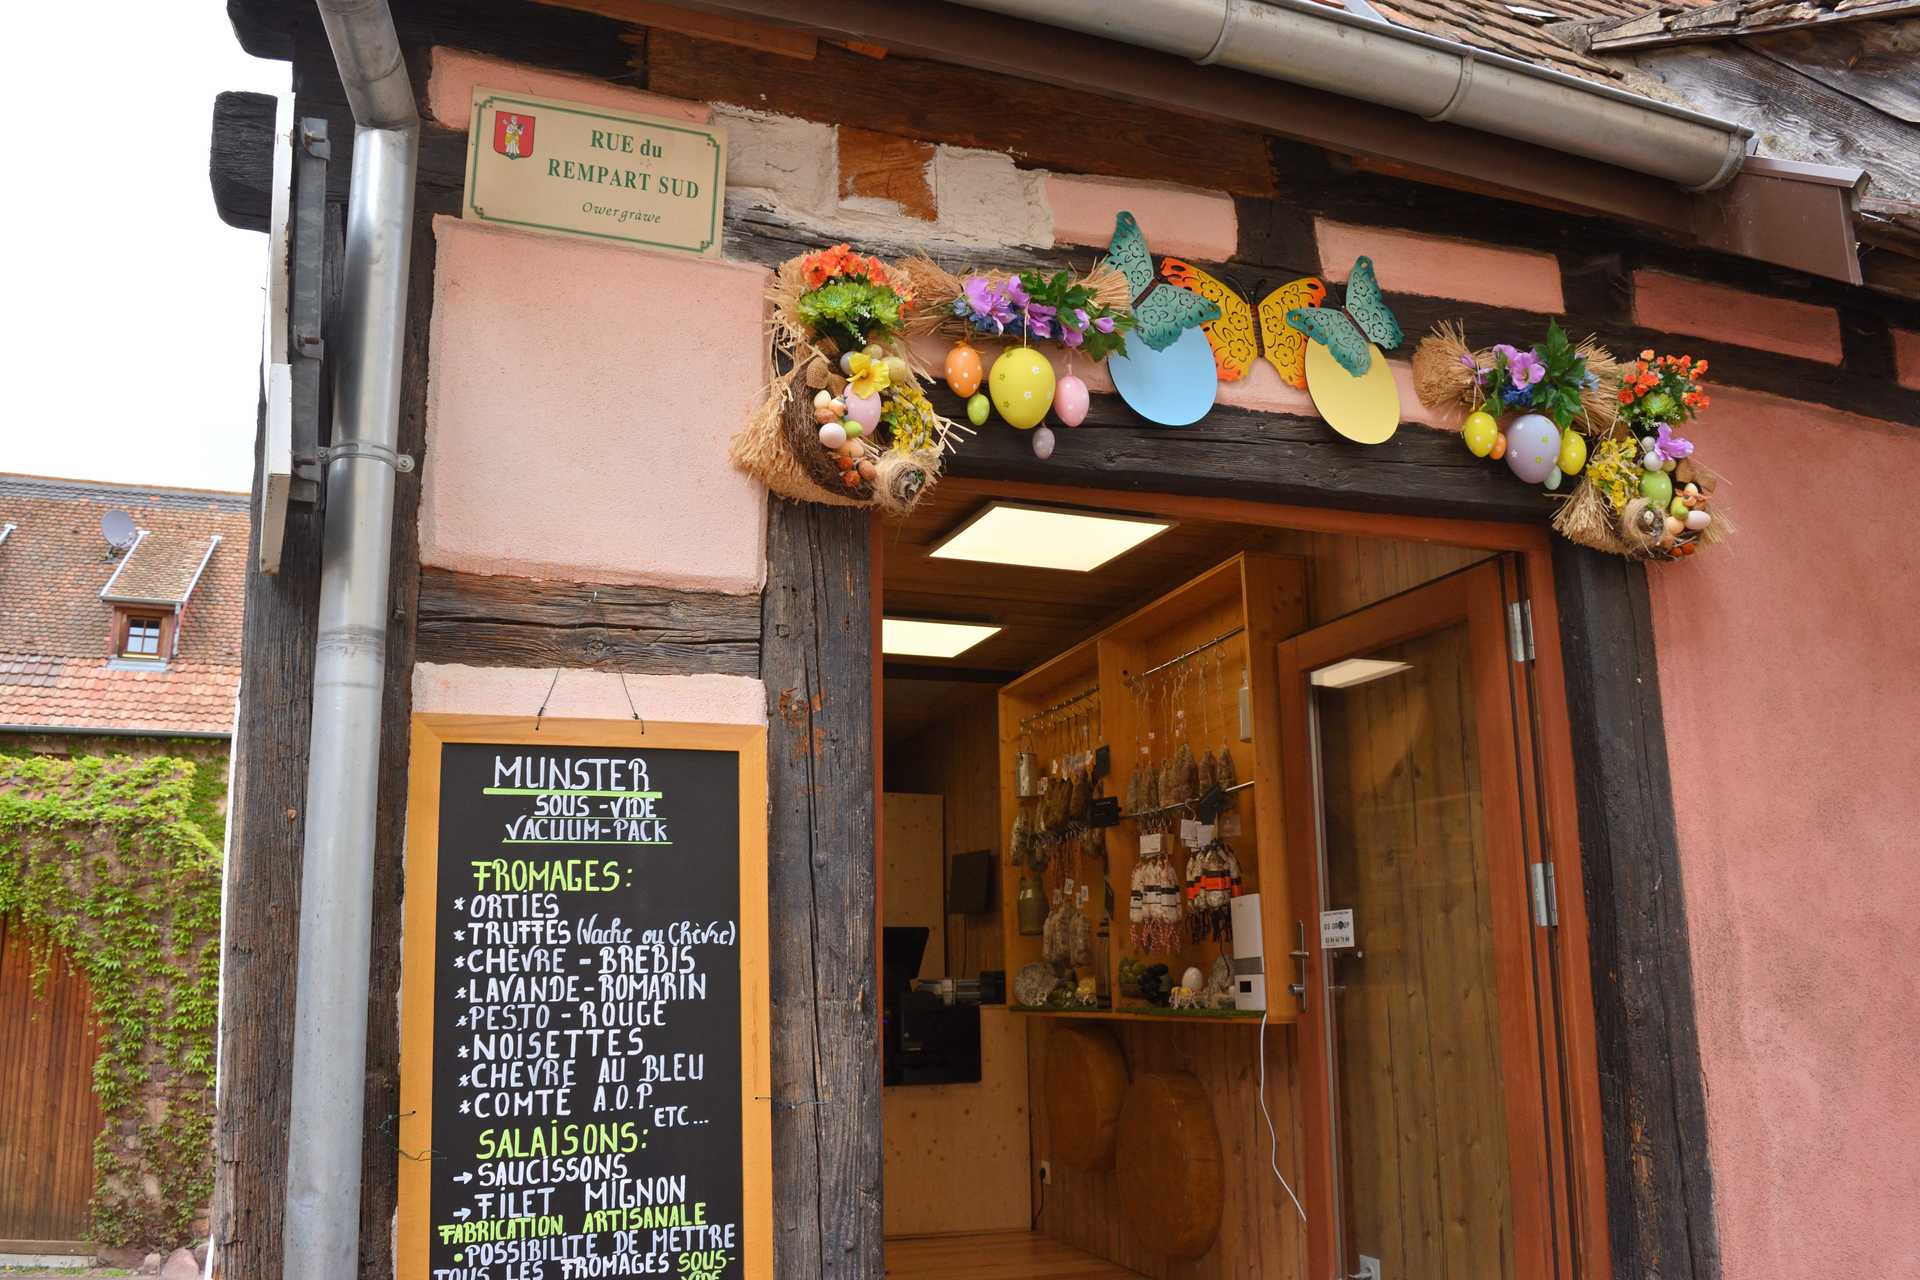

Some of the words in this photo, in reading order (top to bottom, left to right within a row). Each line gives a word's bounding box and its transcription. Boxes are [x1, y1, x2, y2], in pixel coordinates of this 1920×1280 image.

[591, 129, 634, 154] RUE
[639, 138, 663, 158] du
[547, 158, 652, 191] REMPART
[658, 176, 699, 199] SUD
[493, 756, 650, 792] MUNSTER
[534, 796, 590, 817] SOUS
[470, 890, 560, 919] ORTIES
[467, 919, 572, 945] TRUFFES
[576, 913, 633, 946] (Vache
[642, 928, 665, 945] ou
[467, 944, 566, 974] CHÈVRE
[598, 943, 696, 974] BREBIS
[468, 1003, 550, 1031] PESTO
[579, 1000, 667, 1028] ROUGE
[473, 1027, 644, 1061] NOISETTES
[471, 1055, 577, 1089] CHÈVRE
[598, 1058, 625, 1085] AU
[642, 1053, 704, 1081] BLEU
[474, 1085, 572, 1119] COMTÉ
[478, 1153, 628, 1187] SAUCISSONS
[474, 1186, 556, 1219] FILET
[584, 1175, 686, 1211] MIGNON
[438, 1214, 564, 1245] FABRICATION
[582, 1202, 706, 1234] ARTISANALE
[613, 1230, 639, 1256] DE
[652, 1224, 736, 1256] METTRE
[506, 1261, 544, 1280] LES
[561, 1253, 670, 1280] FROMAGES
